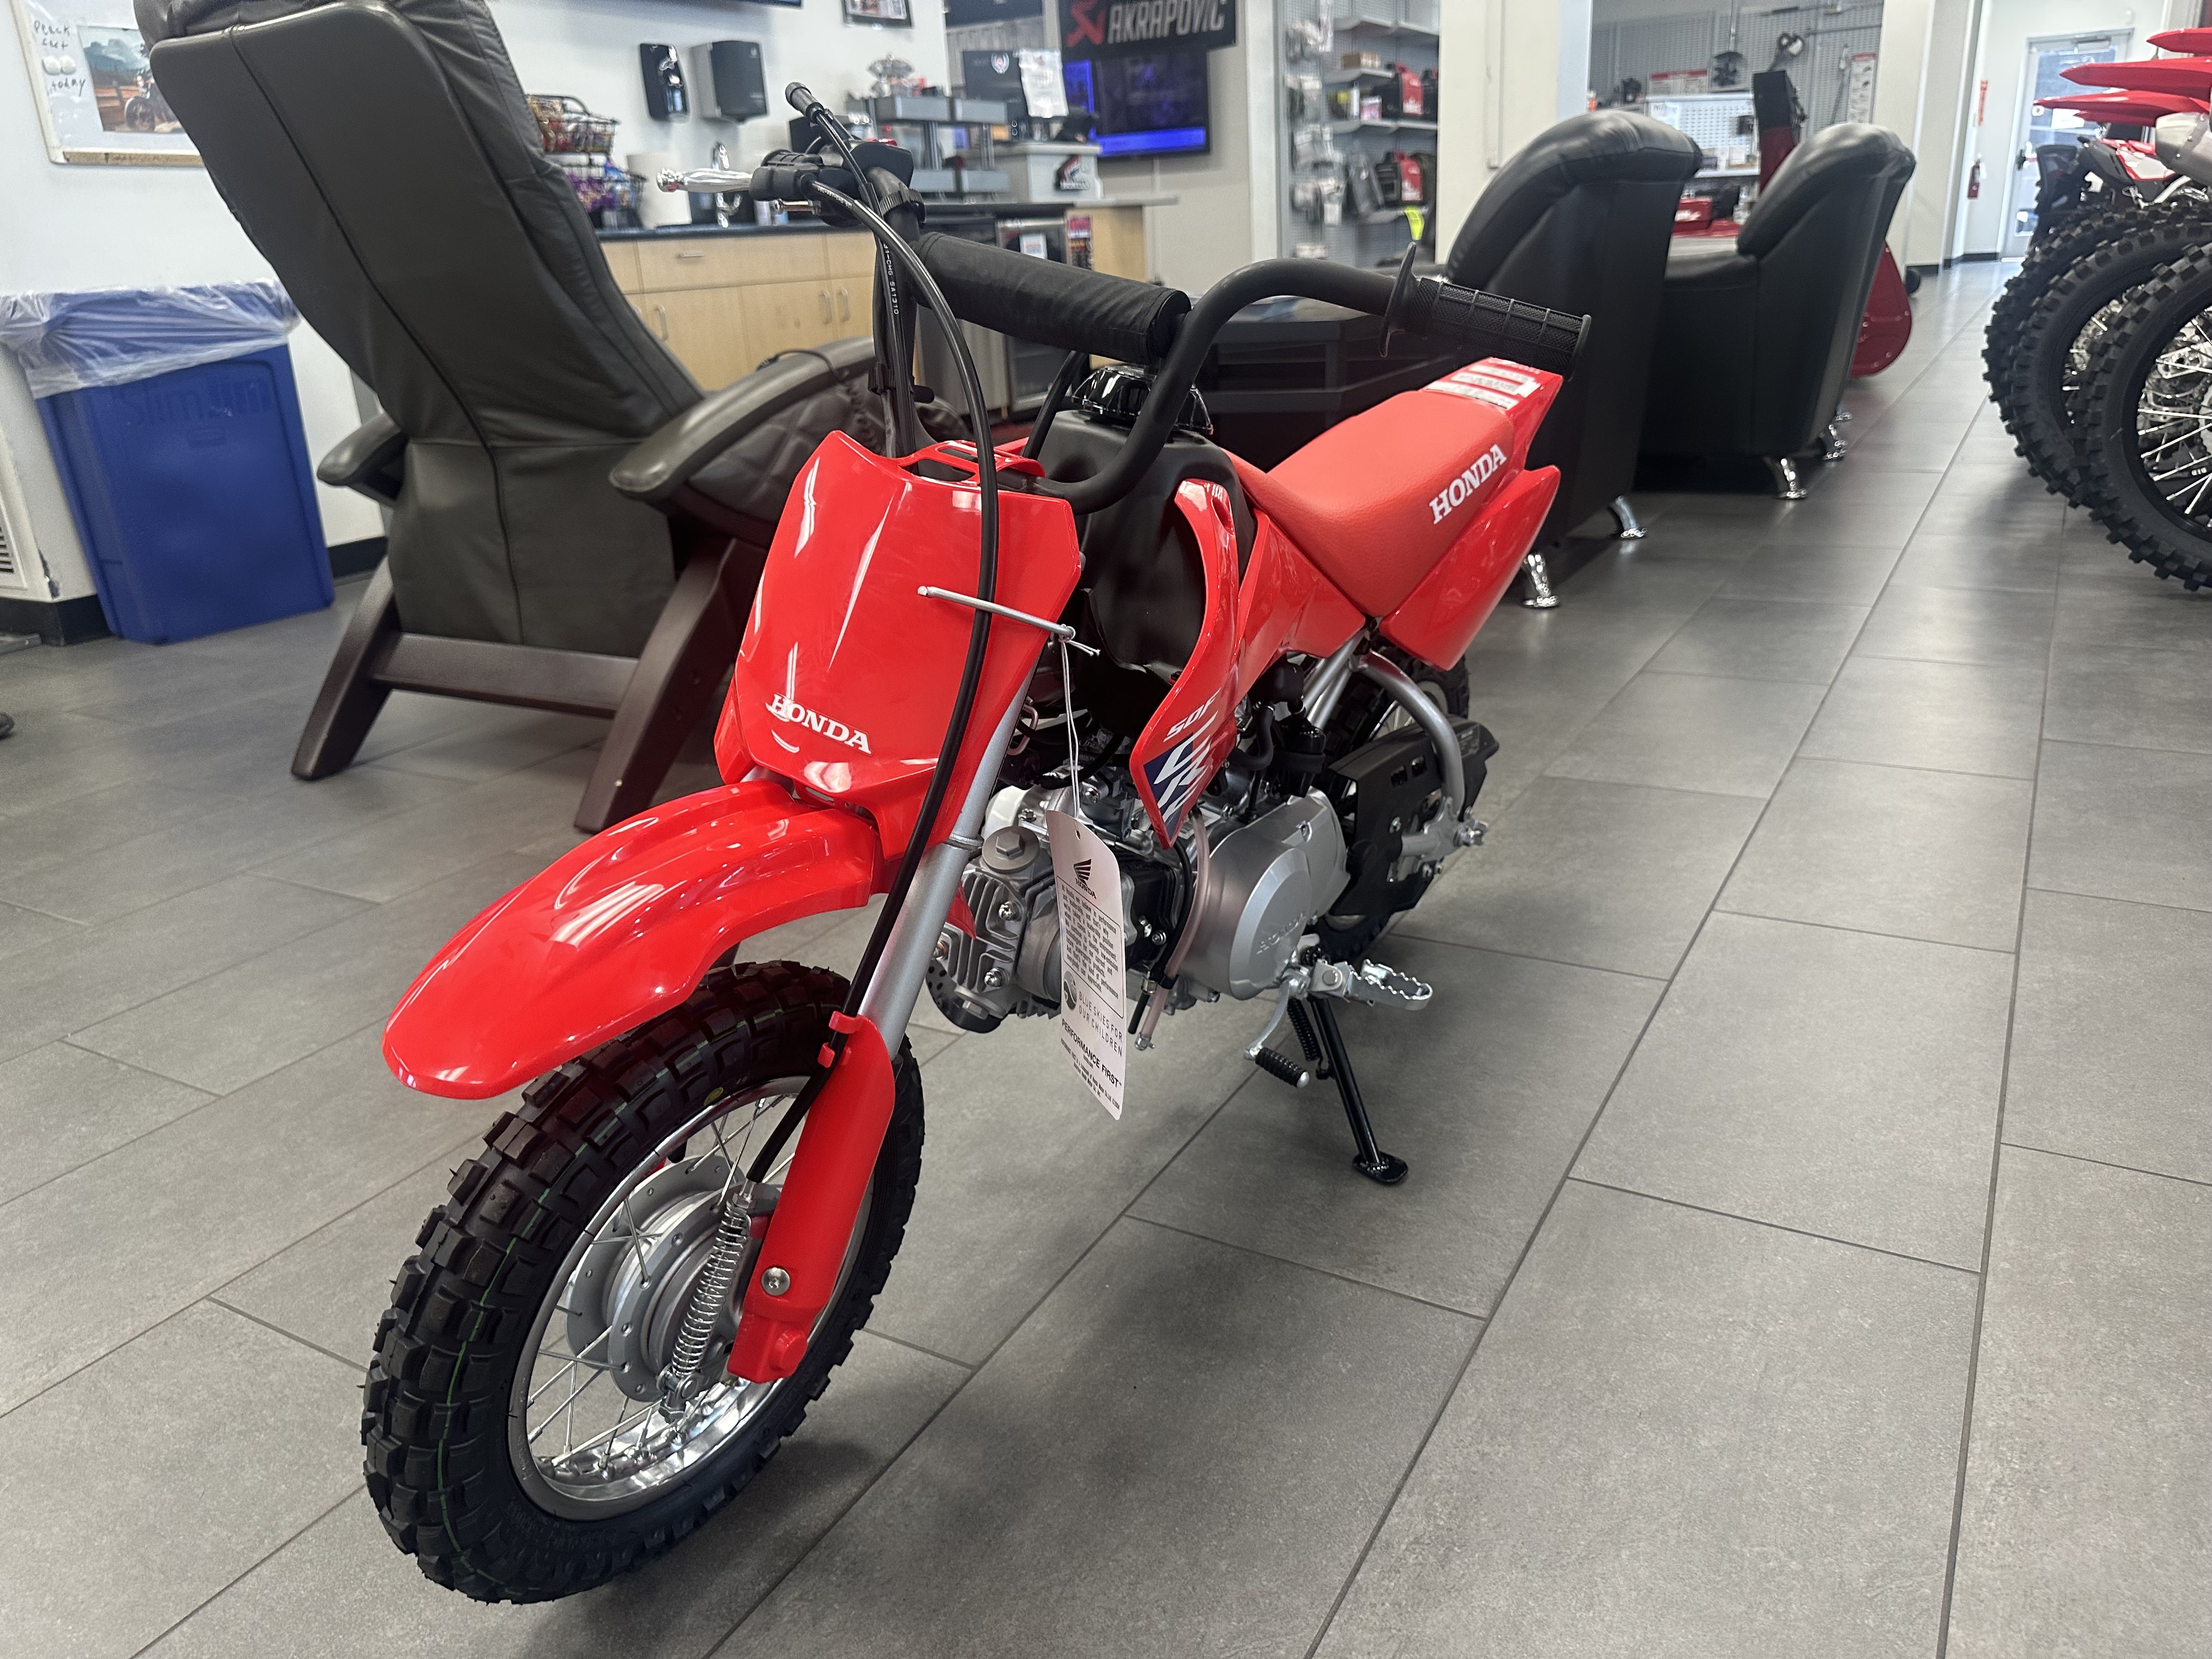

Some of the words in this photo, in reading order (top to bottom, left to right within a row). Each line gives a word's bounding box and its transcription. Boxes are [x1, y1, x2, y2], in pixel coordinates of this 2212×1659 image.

[1429, 444, 1507, 524] HONDA
[771, 693, 872, 754] HONDA
[1075, 878, 1096, 899] HONDA
[1079, 991, 1092, 1012] BLUE
[1093, 1006, 1109, 1029] SKIES
[1111, 1024, 1122, 1042] FOR
[1079, 1005, 1090, 1023] OUR
[1091, 1018, 1122, 1057] CHILDREN
[1062, 1018, 1100, 1069] PERFORMANCE
